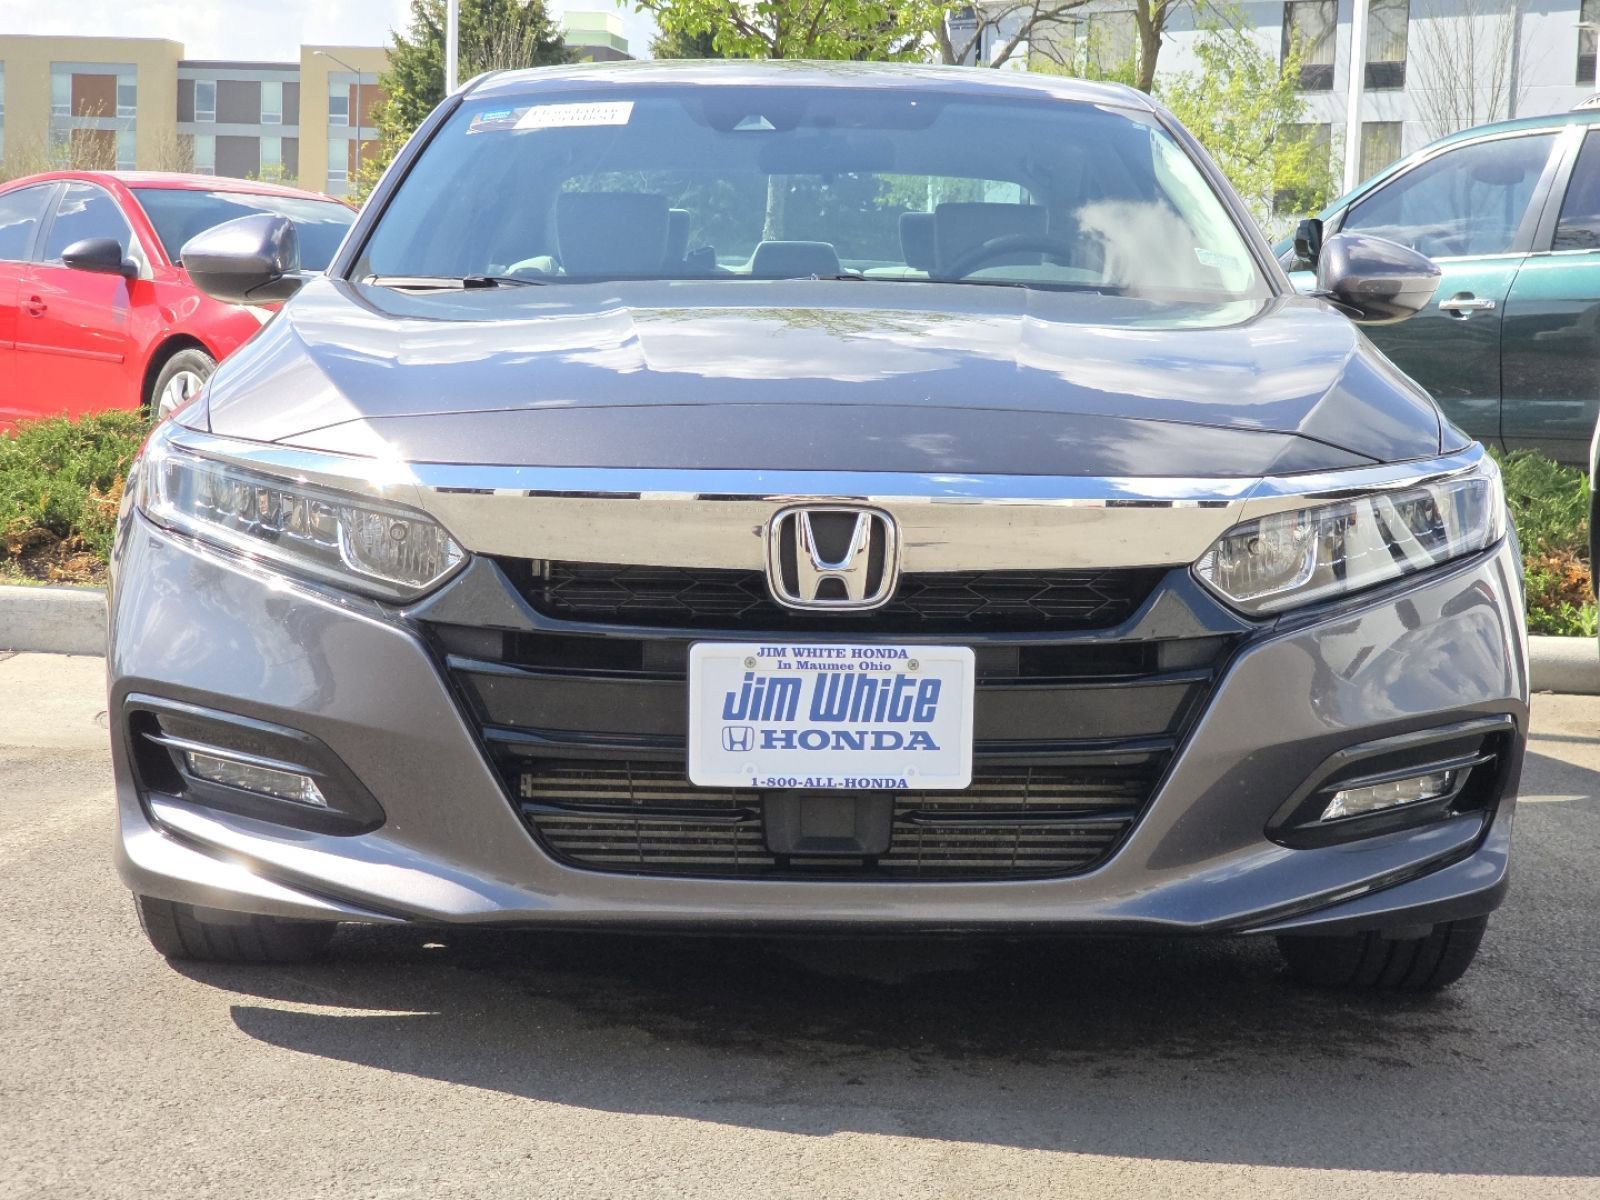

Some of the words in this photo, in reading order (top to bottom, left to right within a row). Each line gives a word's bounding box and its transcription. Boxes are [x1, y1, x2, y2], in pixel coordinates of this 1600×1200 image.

[757, 647, 787, 658] JIM
[791, 648, 848, 659] WHITE
[851, 648, 909, 659] HONDA
[777, 660, 792, 670] In
[795, 660, 855, 671] Maumee
[858, 661, 892, 671] Ohio
[722, 671, 803, 722] Jim
[809, 672, 942, 723] White
[760, 729, 940, 750] HONDA
[751, 777, 909, 789] 1-800-ALL-HONDA
